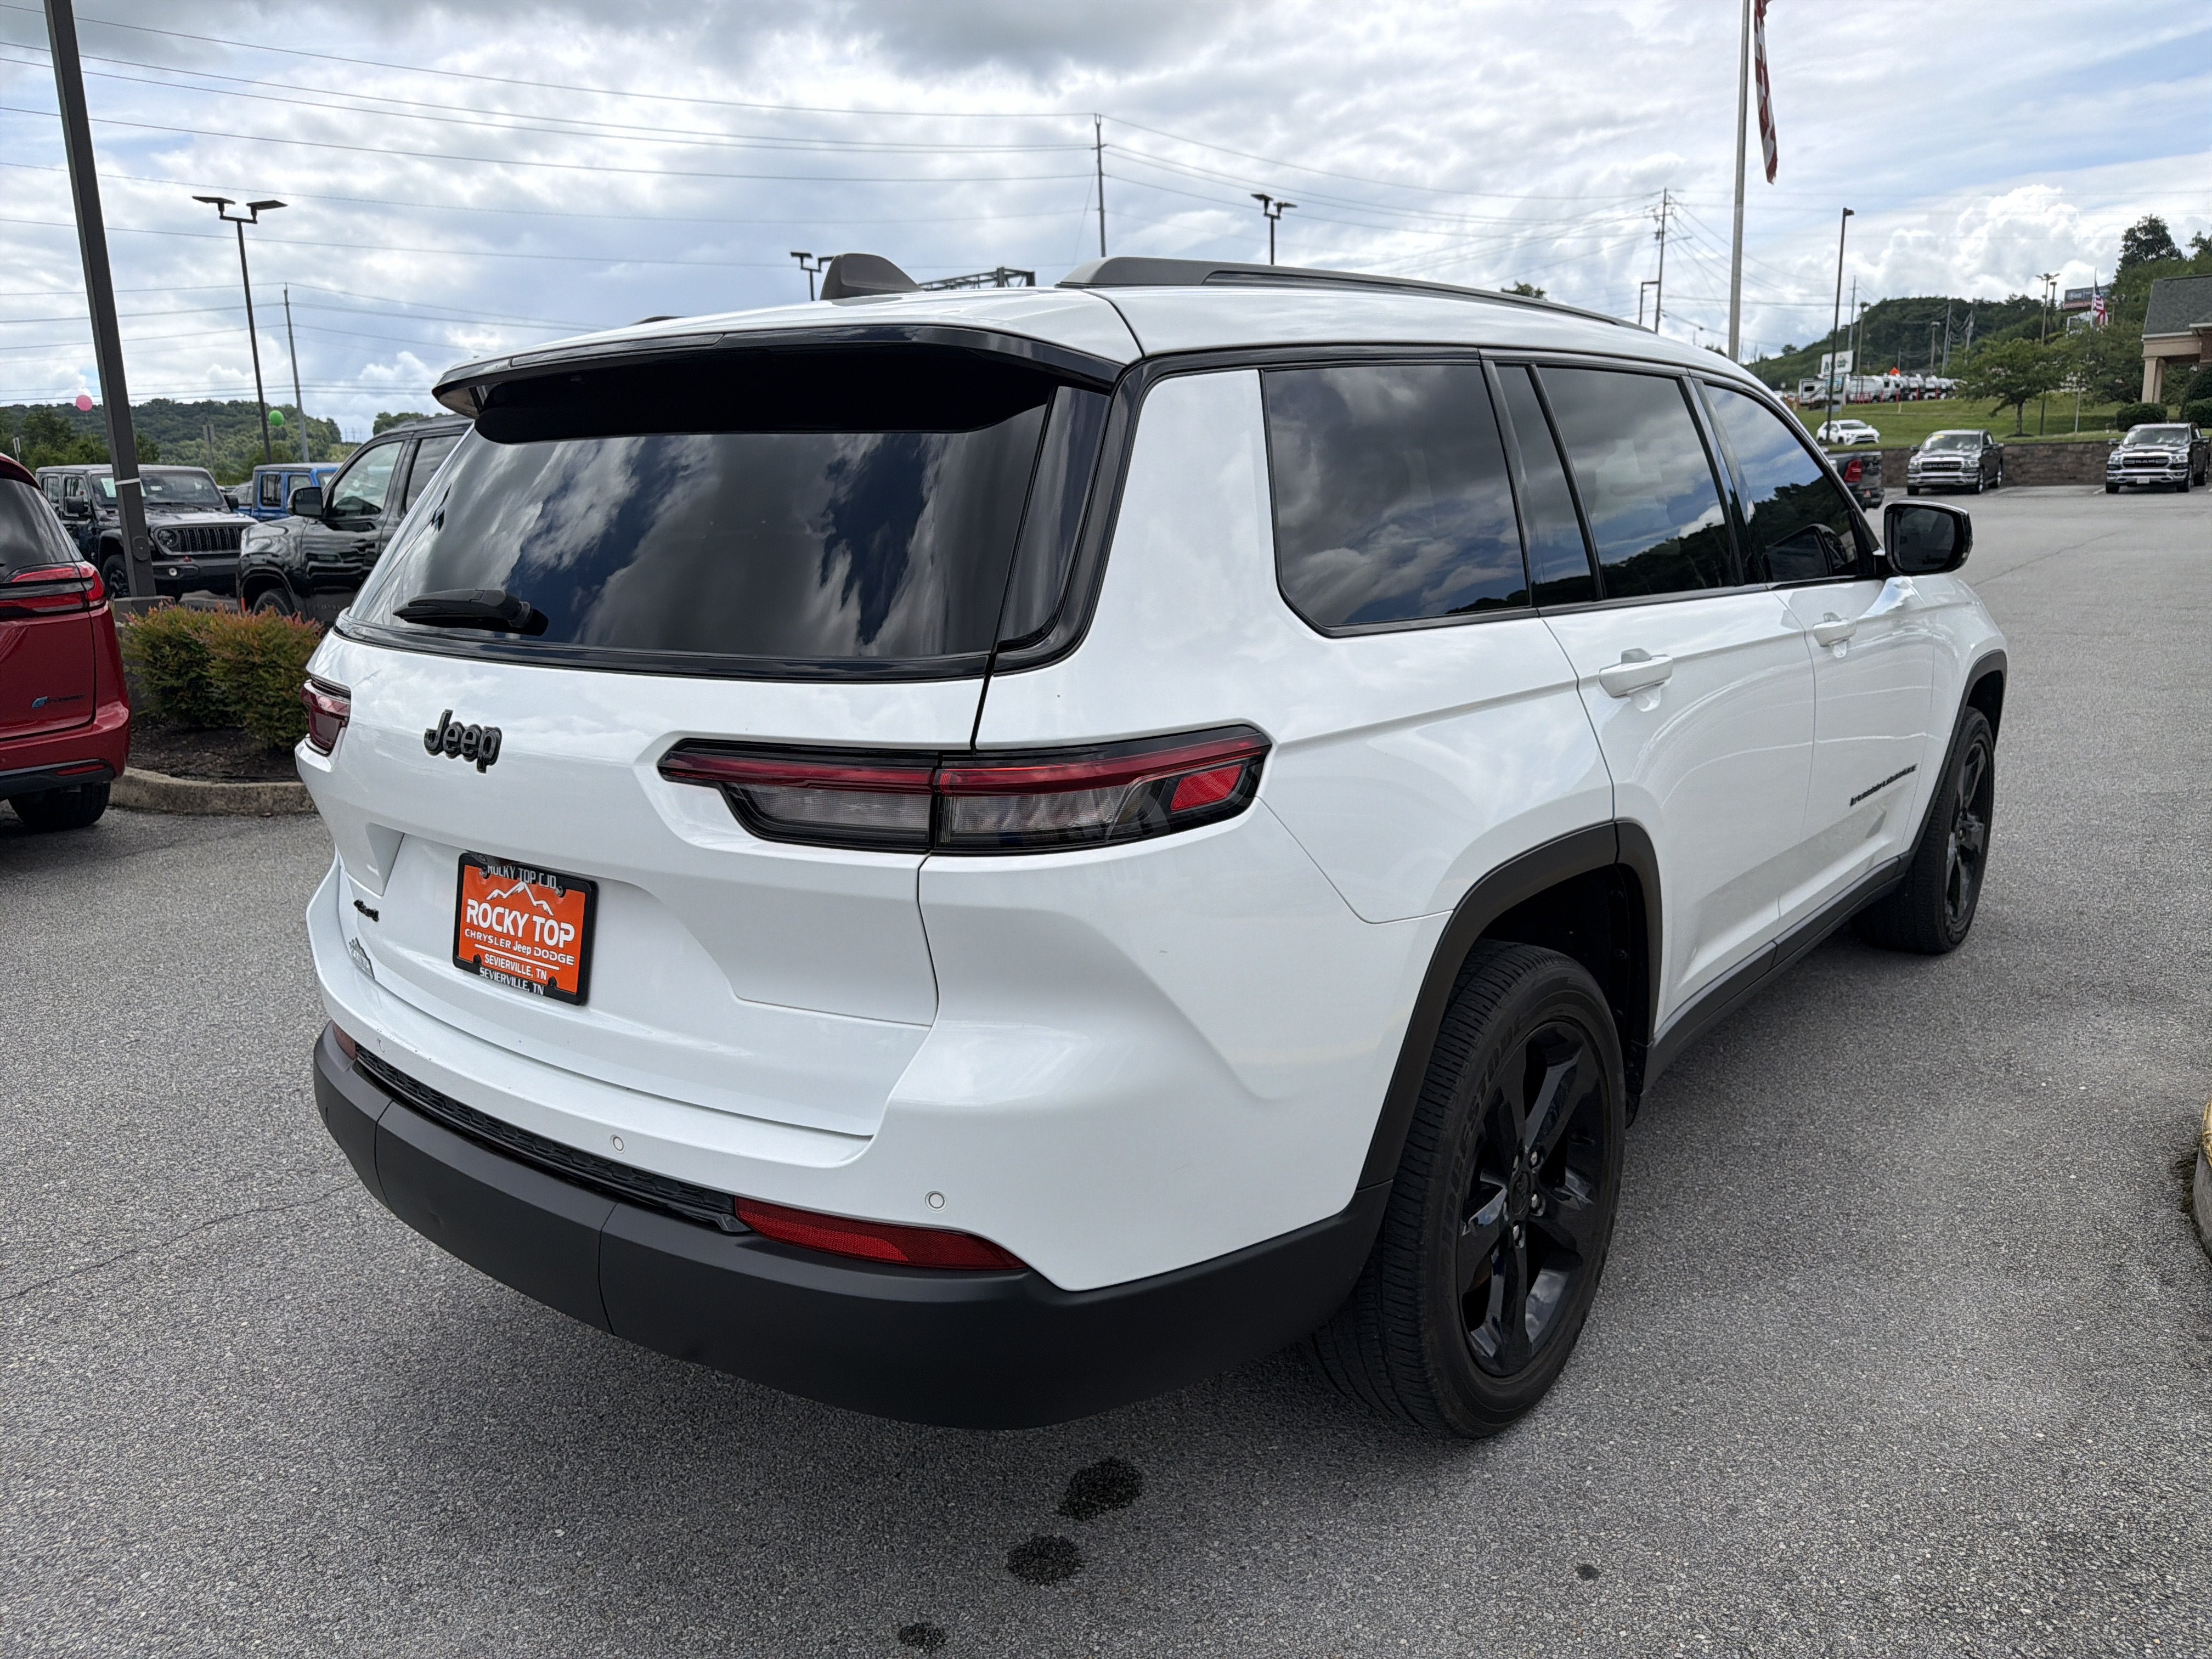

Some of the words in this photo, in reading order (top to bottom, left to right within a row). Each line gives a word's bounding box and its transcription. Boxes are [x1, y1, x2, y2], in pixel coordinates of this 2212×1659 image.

[424, 709, 502, 774] Jeep
[518, 868, 536, 884] TOP
[539, 873, 556, 889] CJD
[466, 898, 530, 938] ROCKY
[532, 916, 575, 949] TOP
[465, 928, 511, 949] CHRYSLER
[513, 940, 532, 956] Jeep
[534, 946, 575, 966] DODGE
[479, 967, 530, 992] SEVIERVILLE,
[532, 982, 544, 996] TN
[484, 953, 534, 979] SEVIERVILLE,
[536, 968, 548, 981] TN
